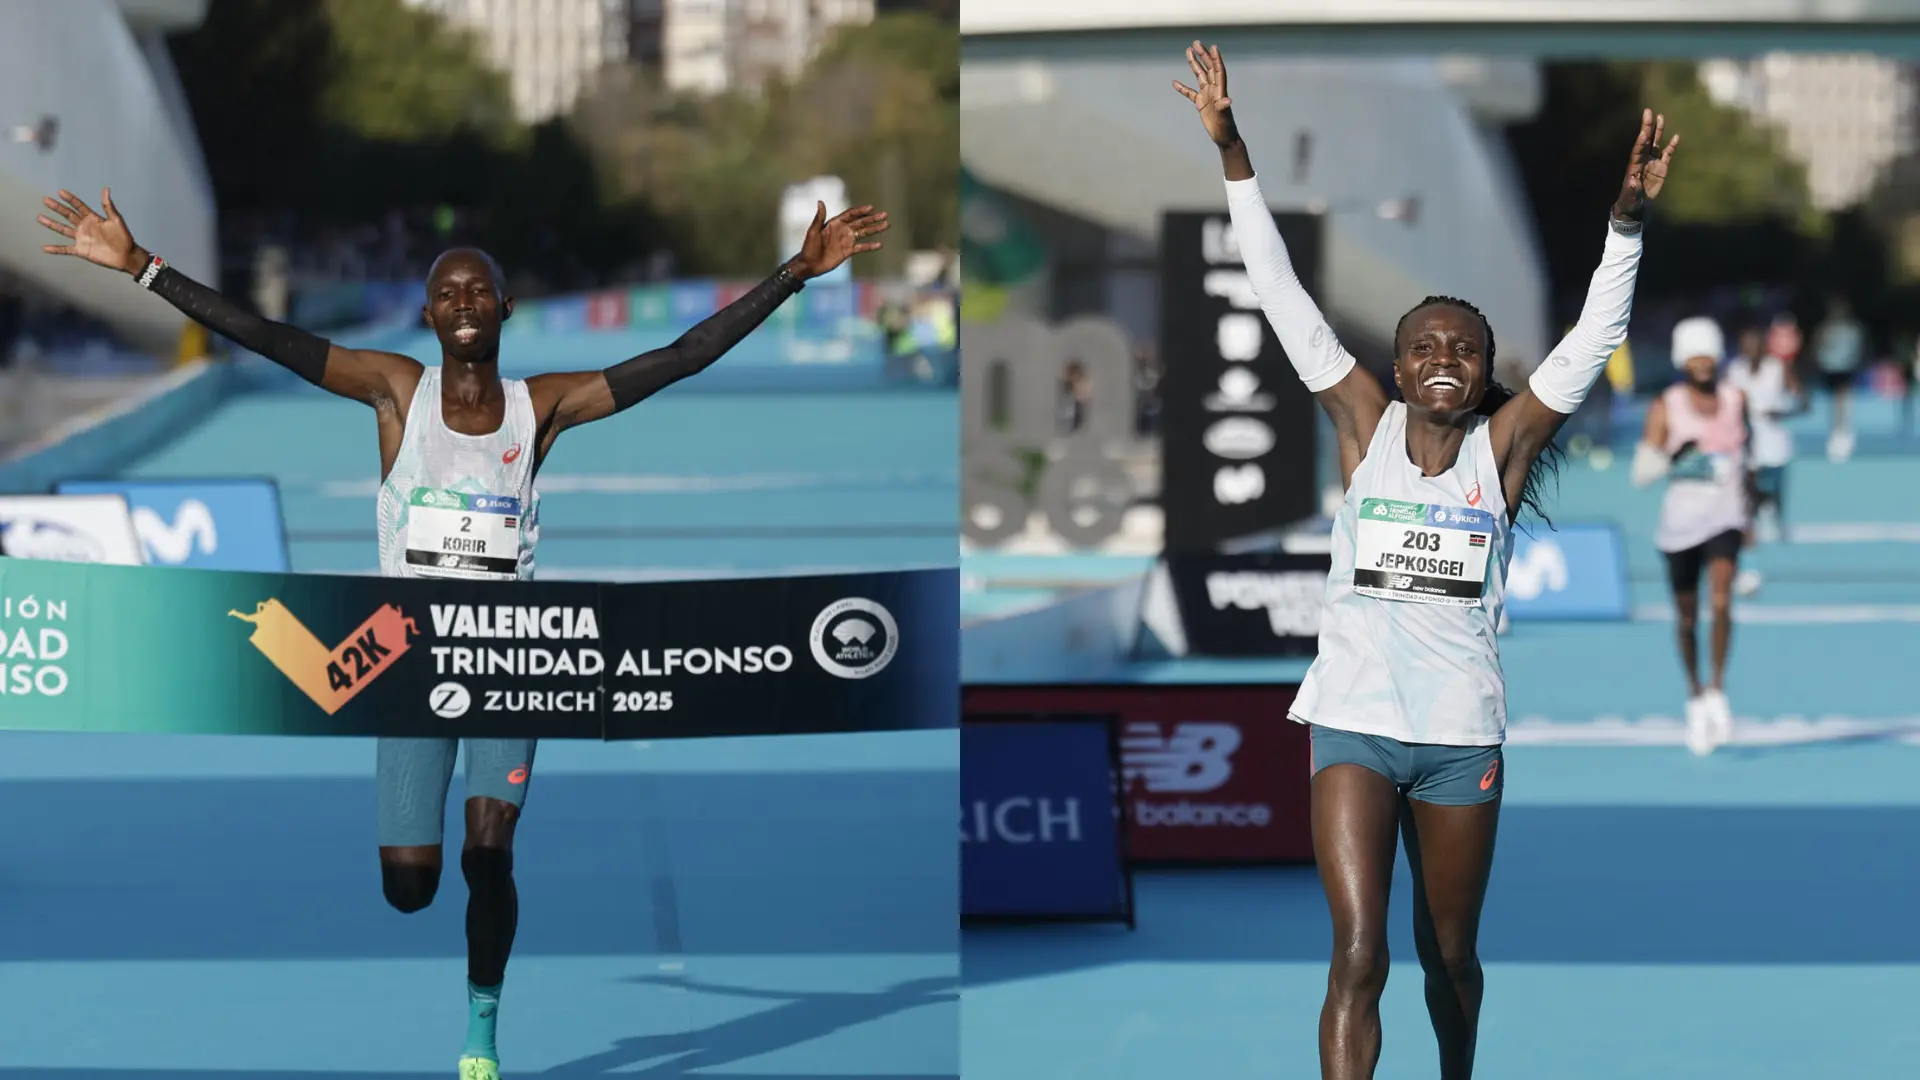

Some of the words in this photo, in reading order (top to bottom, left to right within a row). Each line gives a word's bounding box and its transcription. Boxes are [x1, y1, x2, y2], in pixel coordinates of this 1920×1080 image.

[460, 516, 472, 533] 2
[1449, 514, 1480, 524] ZURICH
[442, 536, 486, 553] KORIR
[1402, 530, 1441, 552] 203
[1375, 552, 1464, 577] JEPKOSGEI
[430, 604, 599, 639] VALENCIA
[0, 626, 68, 660] AD
[326, 629, 392, 694] 42K
[431, 647, 604, 675] TRINIDAD
[616, 645, 793, 676] ALFONSO
[0, 663, 68, 696] SO
[484, 690, 595, 712] ZURICH
[612, 691, 673, 712] 2025
[1135, 801, 1271, 827] balance
